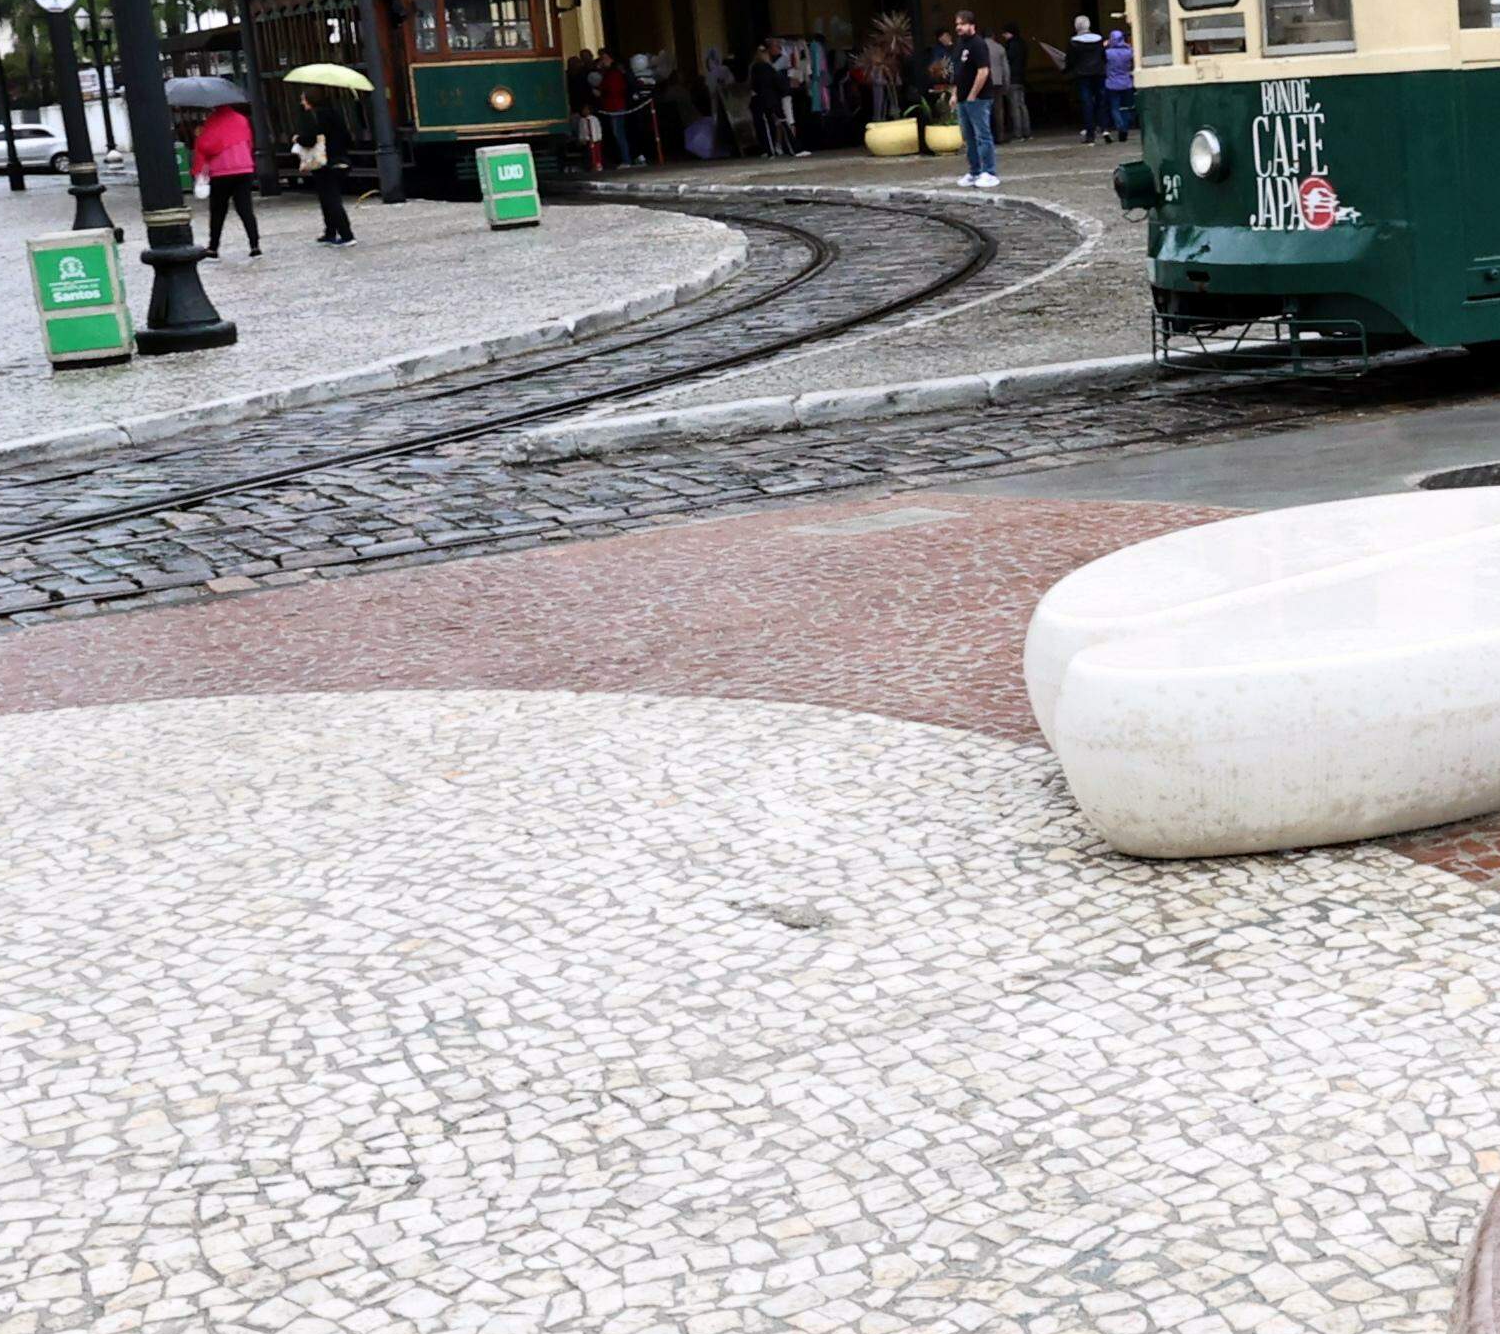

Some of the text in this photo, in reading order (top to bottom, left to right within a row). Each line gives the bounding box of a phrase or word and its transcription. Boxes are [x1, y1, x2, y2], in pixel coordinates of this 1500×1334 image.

[1261, 79, 1312, 115] BONDE
[1252, 102, 1328, 178] CAFÉ
[52, 289, 101, 303] Santos
